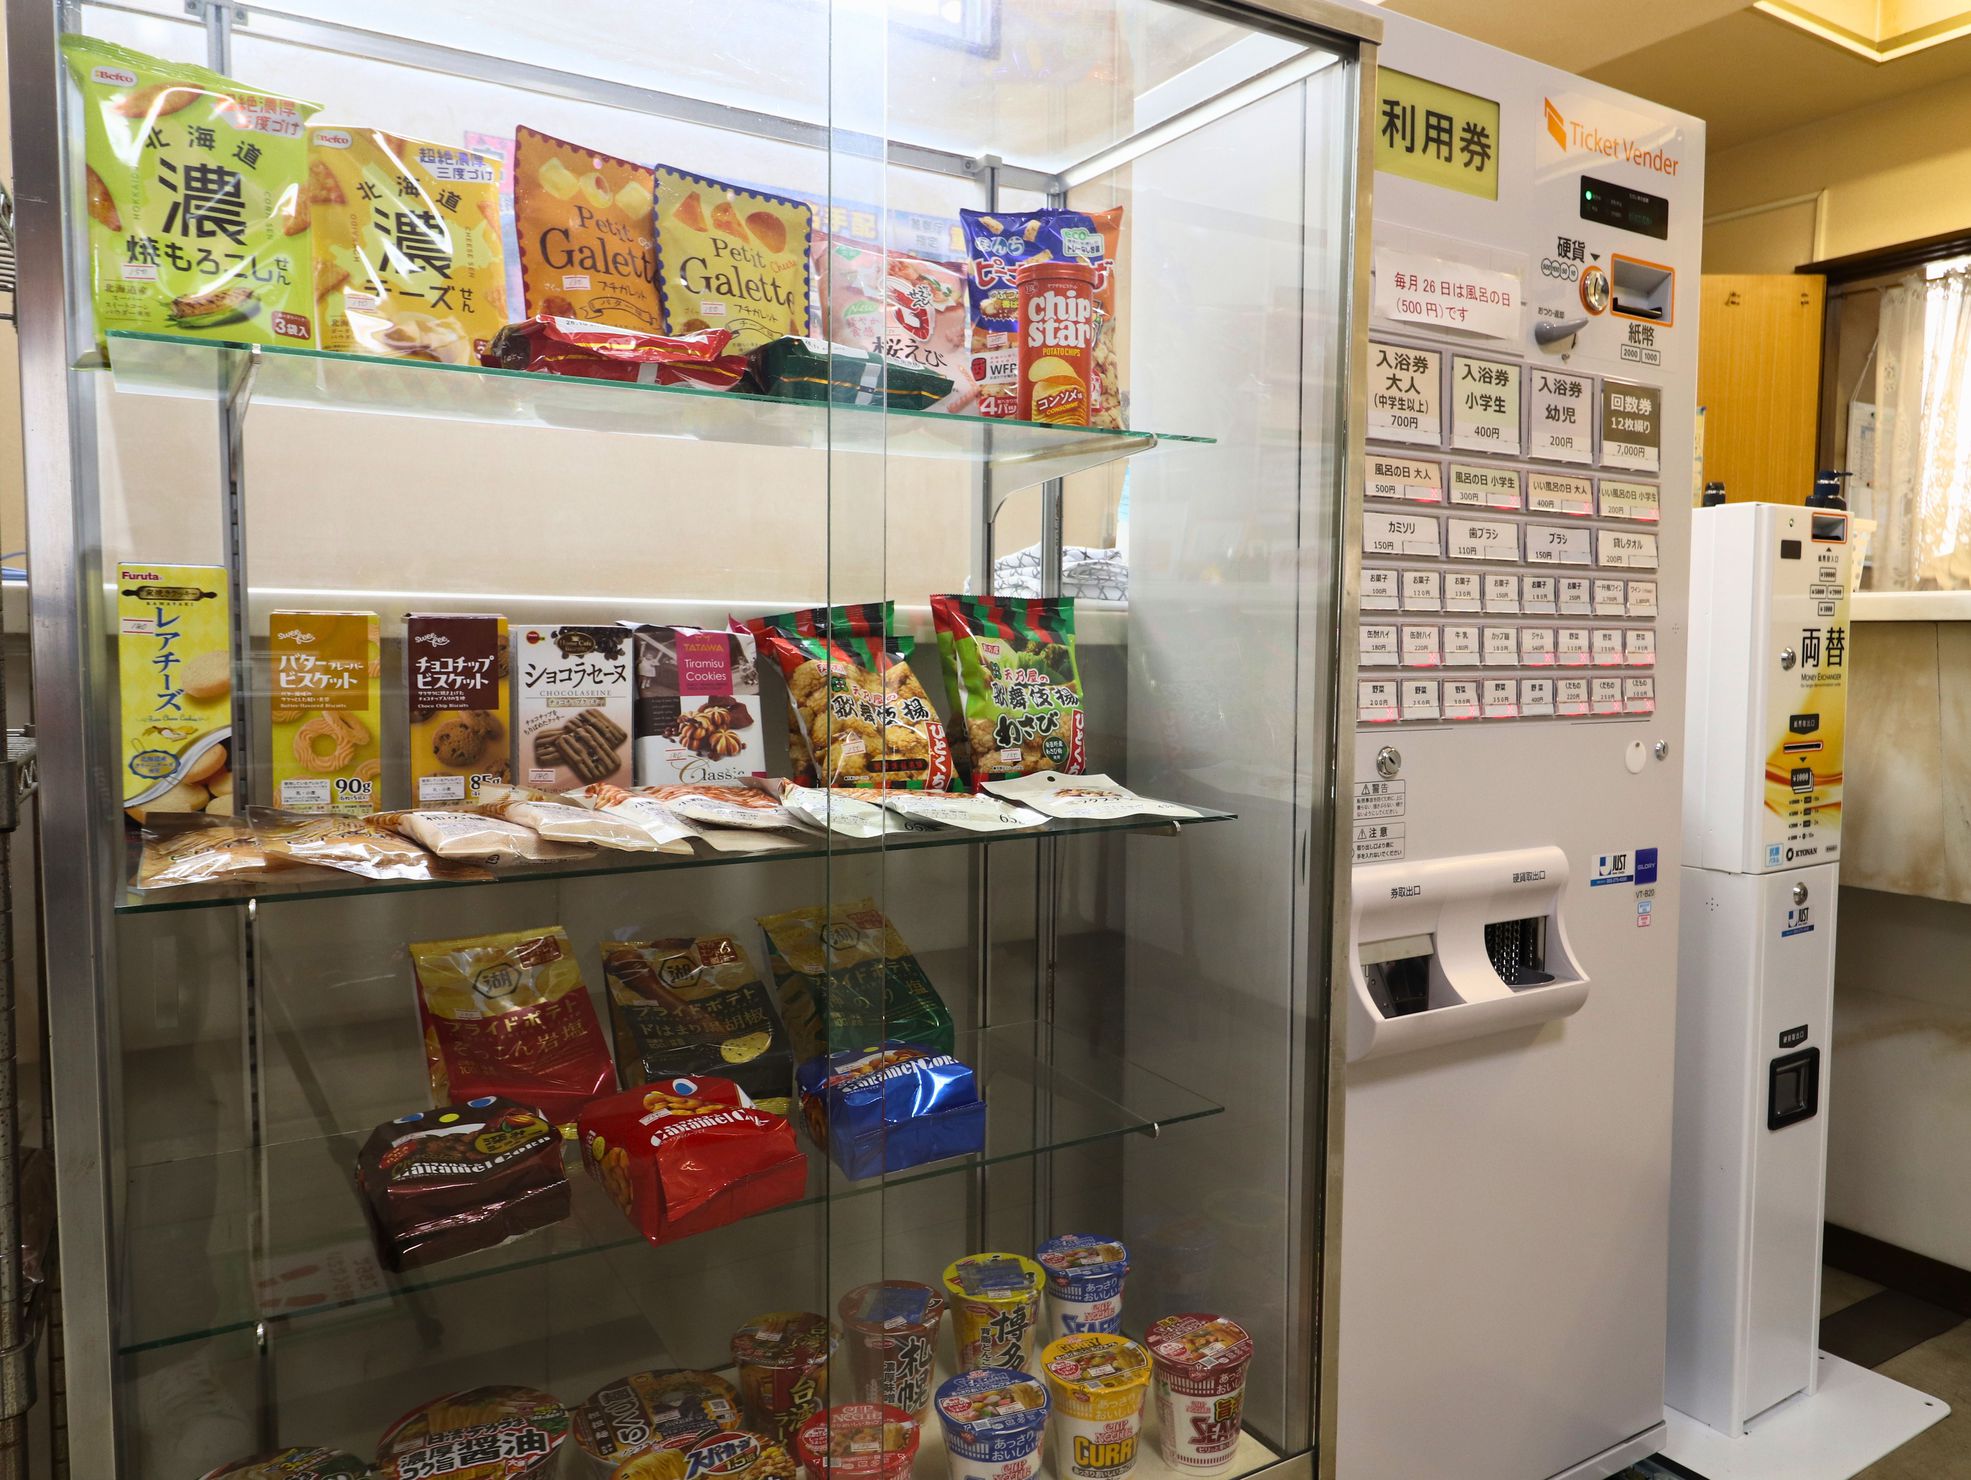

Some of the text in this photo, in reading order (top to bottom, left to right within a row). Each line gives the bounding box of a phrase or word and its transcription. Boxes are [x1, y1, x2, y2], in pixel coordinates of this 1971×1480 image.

[98, 71, 134, 83] Befco
[317, 134, 349, 145] Befco
[1382, 98, 1492, 173] 利用券
[145, 125, 262, 170] 北海道
[1569, 121, 1680, 177] Ticket Vender
[418, 147, 486, 168] 超絶濃厚
[437, 166, 493, 182] 三度づけ
[158, 157, 248, 246] 濃
[355, 175, 463, 214] 北海道
[573, 204, 635, 243] Petit
[373, 207, 453, 280] 濃
[1064, 229, 1087, 240] eco
[539, 227, 653, 285] Galett
[709, 236, 767, 269] Petit
[1557, 235, 1586, 264] 硬貨
[274, 256, 292, 286] せん
[364, 279, 456, 311] チーズ
[680, 256, 796, 316] Galette
[1394, 272, 1511, 308] 毎月 26 日は風呂の日
[459, 287, 475, 314] せん
[1028, 290, 1092, 322] chip
[1396, 299, 1470, 324] (500 円)です
[275, 318, 309, 338] 3袋入
[1028, 318, 1092, 348] star
[1628, 322, 1655, 348] 紙幣
[871, 336, 947, 368] 桜えび
[1623, 349, 1658, 363] 2000 1000
[1376, 350, 1429, 375] 入浴券
[1385, 373, 1421, 396] 大人
[1461, 363, 1510, 388] 入浴券
[1538, 376, 1583, 399] 入浴券
[1037, 388, 1084, 411] コンソメ味
[1373, 392, 1429, 415] (中学生以上)
[1464, 391, 1507, 414] 小学生
[1610, 393, 1653, 416] 回数券
[1390, 414, 1419, 430] 700円
[1544, 404, 1577, 425] 幼児
[1474, 425, 1501, 440] 400円
[1610, 416, 1651, 435] 12枚綴り
[1549, 435, 1574, 449] 200円
[1616, 444, 1646, 458] 7,000円
[1374, 462, 1432, 481] 風呂の日 大人
[1455, 471, 1516, 490] 風呂の日 小学生
[1375, 484, 1396, 495] 500円
[1460, 491, 1479, 502] 300円
[1533, 481, 1588, 496] いい風呂の日 大人
[1601, 487, 1658, 503] いい風呂の日 小学生
[1536, 499, 1555, 509] 400円
[1608, 505, 1624, 515] 200円
[1388, 521, 1416, 535] カミソリ
[1468, 527, 1499, 541] 歯ブラシ
[1373, 541, 1395, 551] 150円
[1548, 532, 1568, 546] ブラシ
[1612, 537, 1644, 551] 貸しタオル
[1458, 546, 1477, 556] 110円
[1535, 551, 1553, 561] 150円
[1606, 555, 1623, 565] 200円
[121, 571, 160, 581] Furuta
[1369, 574, 1388, 584] お菓子
[1412, 576, 1431, 585] お菓子
[1454, 577, 1472, 586] お菓子
[1493, 580, 1510, 589] お菓子
[1531, 581, 1548, 590] お菓子
[1566, 582, 1582, 591] お菓子
[683, 643, 724, 652] TATAWA
[1801, 627, 1845, 669] 両替
[151, 606, 185, 713] レアチーズ
[415, 655, 495, 673] チョコチップ
[684, 659, 725, 669] Tiramisu
[279, 672, 359, 690] ビスケット
[417, 672, 490, 690] ビスケット
[524, 662, 628, 689] ショコラセーヌ
[685, 671, 727, 682] Cookies
[1003, 668, 1050, 684] 天乃屋の
[539, 689, 612, 697] CHOCOLASEINE
[991, 681, 1080, 711] 歌舞伎揚
[1371, 685, 1385, 694] 野菜
[1414, 686, 1427, 695] 野菜
[1454, 685, 1466, 694] 野菜
[1494, 683, 1506, 692] 野菜
[993, 709, 1061, 748] わさび
[1069, 711, 1085, 776] ひとくち
[929, 723, 947, 790] ひとくち
[335, 778, 372, 794] 90g
[1372, 783, 1389, 794] 警告
[1368, 826, 1388, 839] 注意
[1612, 854, 1627, 871] JUST
[1637, 863, 1656, 871] GLORY
[1512, 870, 1546, 884] 硬貨取出口
[1390, 885, 1422, 900] 券取出口
[482, 970, 513, 993] 湖
[631, 988, 757, 1018] フライドポテト
[449, 999, 578, 1034] フライドポテト
[841, 1060, 918, 1094] Caramel
[650, 1112, 735, 1147] Caramel
[1085, 1277, 1118, 1293] あっさり
[989, 1304, 1029, 1372] 博多
[893, 1335, 934, 1416] 札幌
[457, 1428, 550, 1467] 醤油
[994, 1430, 1035, 1450] あっさり
